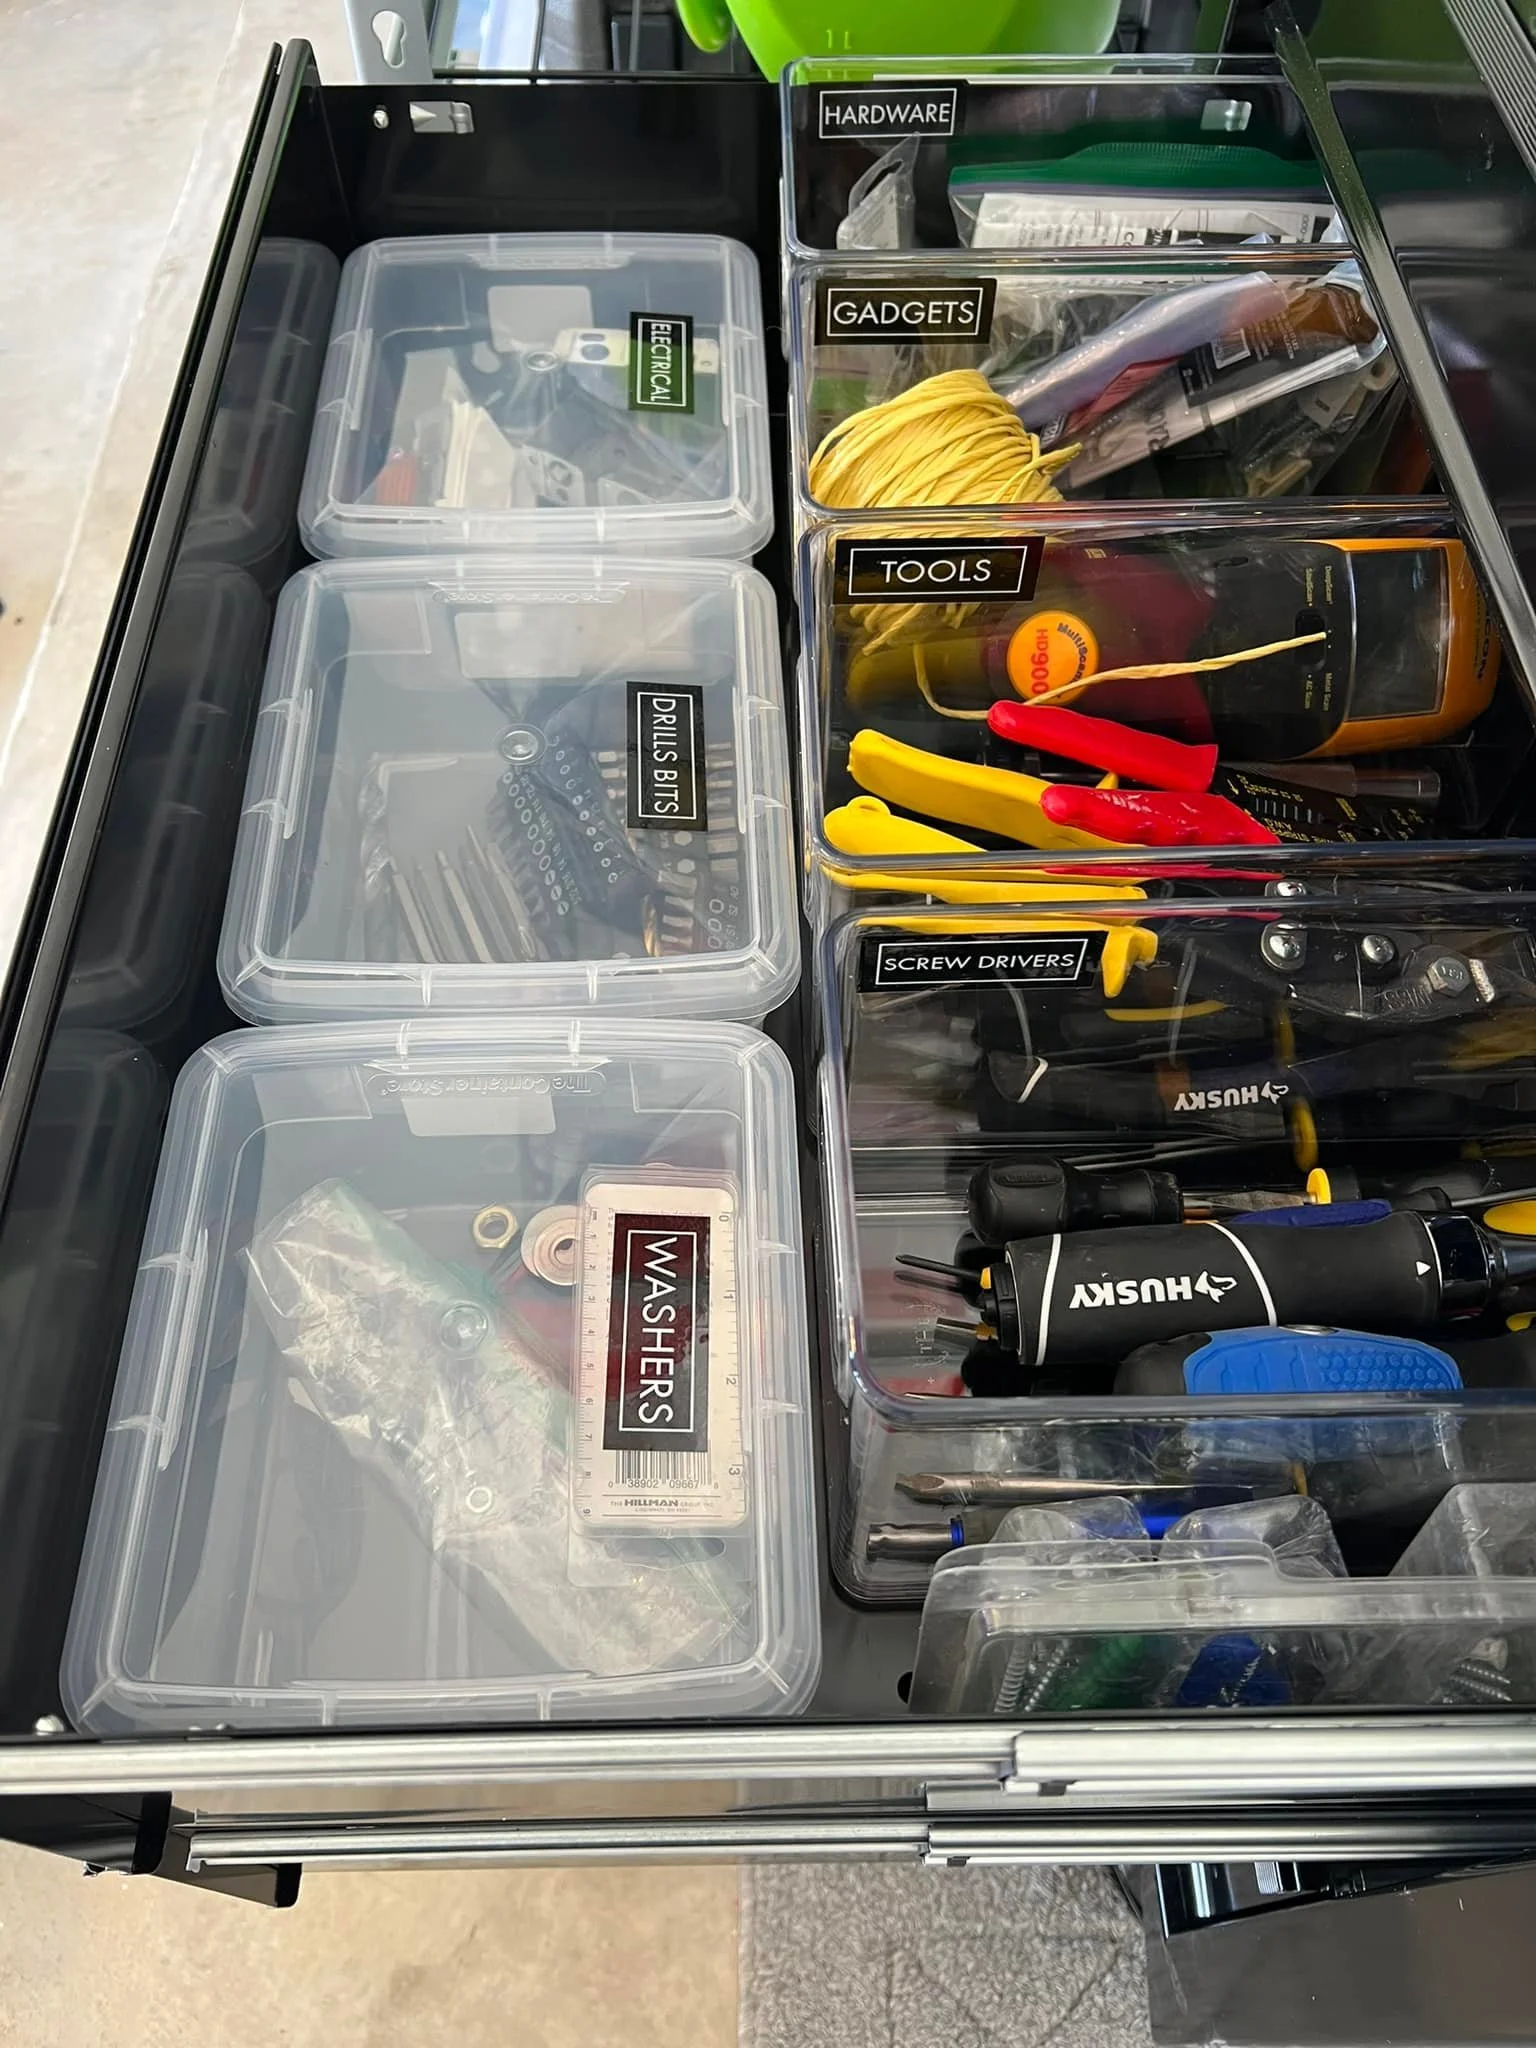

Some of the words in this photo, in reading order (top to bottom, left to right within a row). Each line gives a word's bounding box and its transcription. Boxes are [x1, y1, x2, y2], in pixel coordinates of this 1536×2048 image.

[824, 103, 951, 125] HARDWARE
[832, 300, 975, 325] GADGETS
[650, 322, 673, 402] ELECTRICAL
[880, 559, 992, 584] TOOLS
[1030, 628, 1049, 695] HD900
[1056, 622, 1089, 684] MultiScan
[652, 697, 678, 762] DRILLS
[653, 769, 680, 814] BITS
[884, 955, 972, 971] SCREW
[978, 953, 1075, 969] DRIVERS
[447, 1076, 551, 1095] Container
[552, 1074, 592, 1094] The
[1174, 1084, 1259, 1111] HUSKY
[1070, 1275, 1192, 1309] HUSKY
[638, 1236, 679, 1424] WASHERS
[725, 1377, 737, 1386] 2
[728, 1466, 741, 1476] 3
[627, 1479, 659, 1489] 38902
[668, 1479, 699, 1489] 09667
[624, 1499, 679, 1507] HILLMAN
